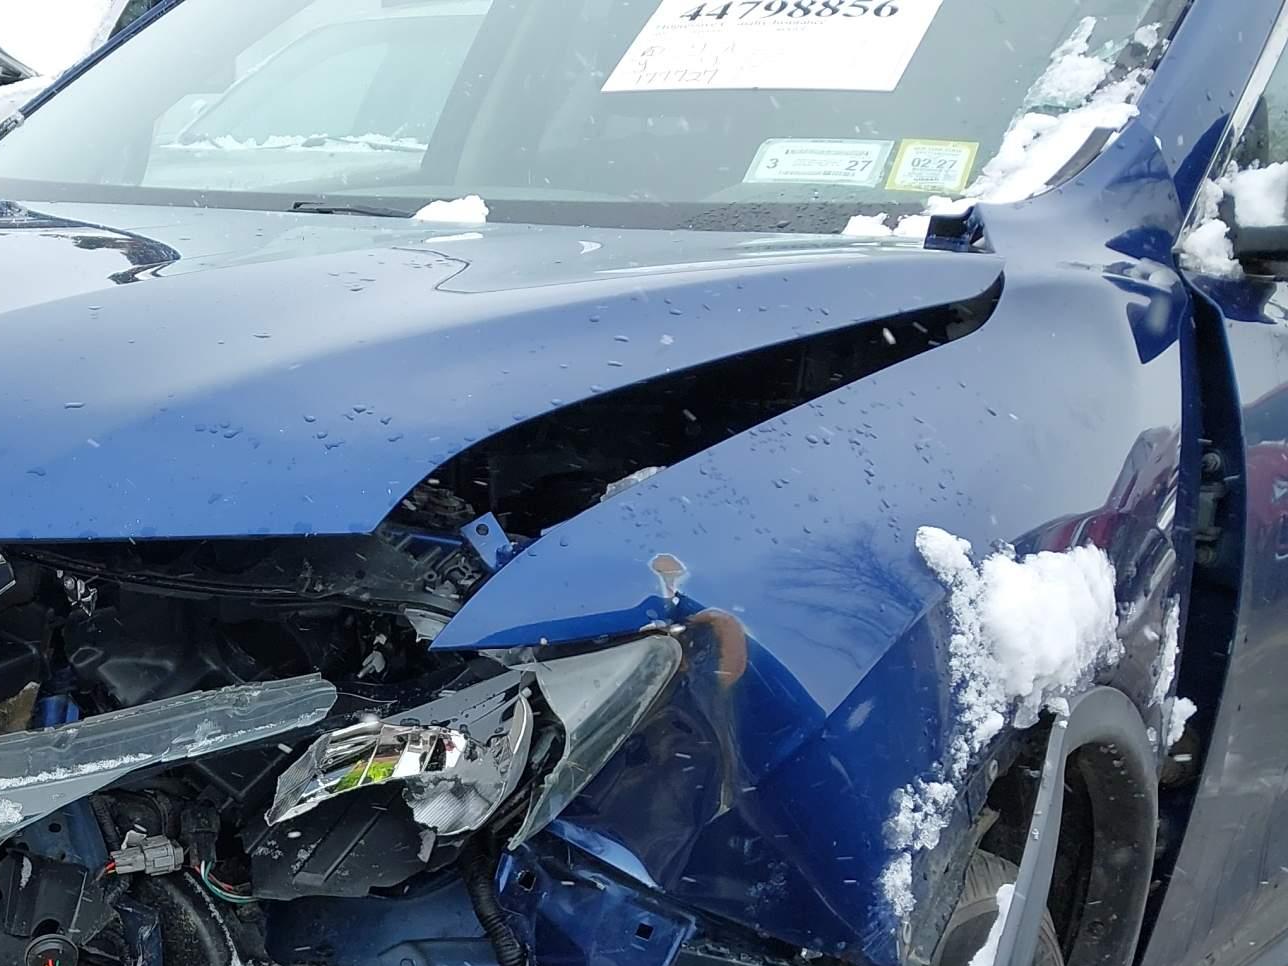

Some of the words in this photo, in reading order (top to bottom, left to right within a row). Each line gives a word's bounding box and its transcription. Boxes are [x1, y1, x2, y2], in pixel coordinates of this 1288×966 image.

[680, 0, 900, 21] 44798856
[766, 158, 779, 170] 3
[845, 159, 873, 172] 27
